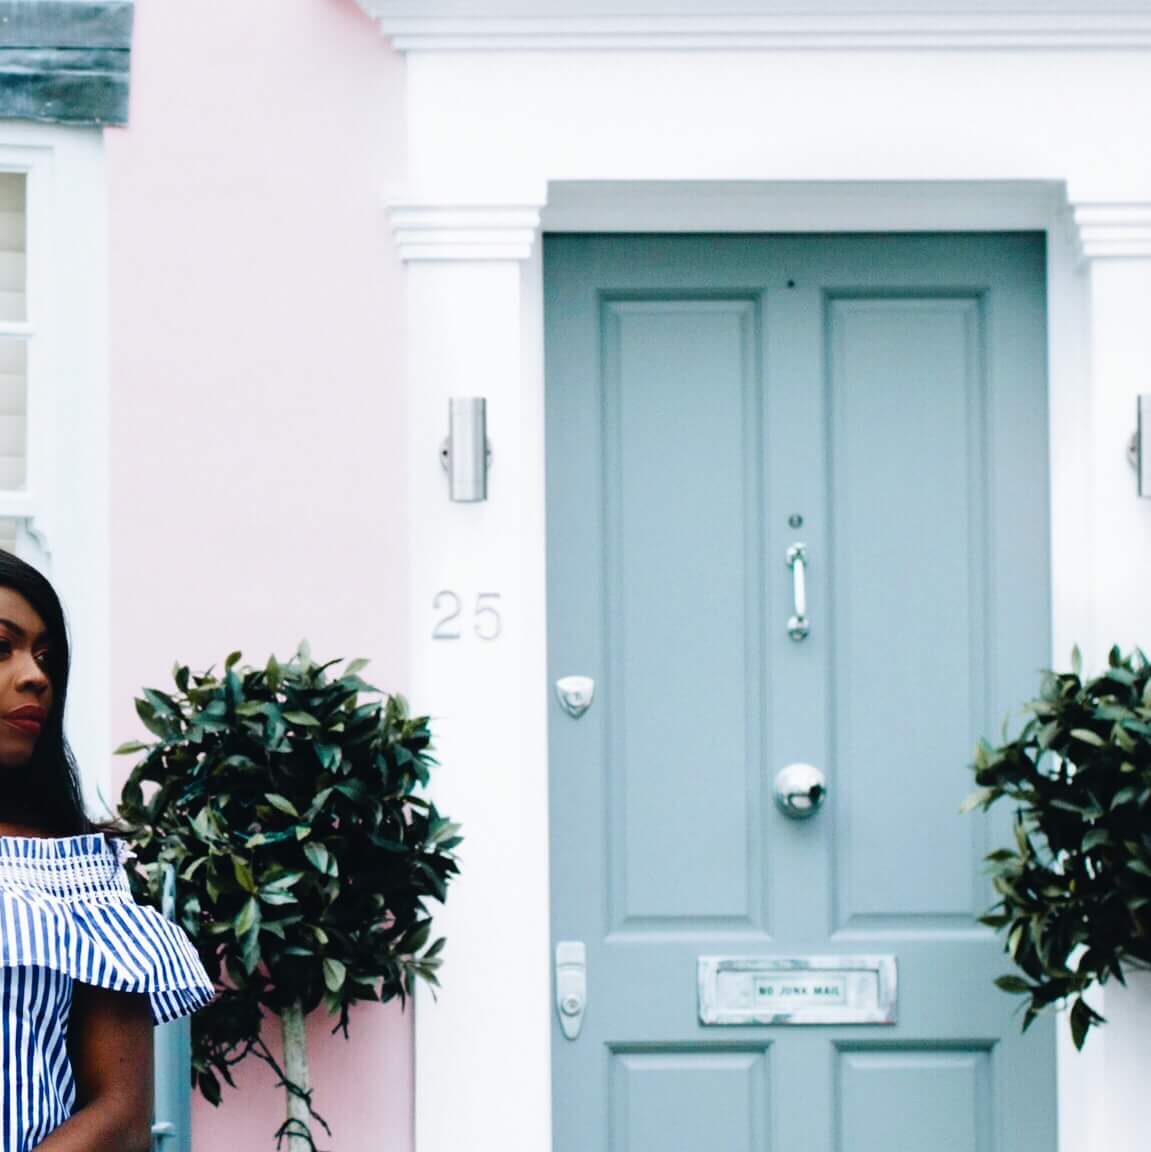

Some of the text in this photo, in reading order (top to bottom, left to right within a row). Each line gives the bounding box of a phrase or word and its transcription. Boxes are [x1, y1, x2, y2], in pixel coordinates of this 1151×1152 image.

[432, 590, 503, 641] 25
[759, 986, 840, 996] NO JUNK MAIL
